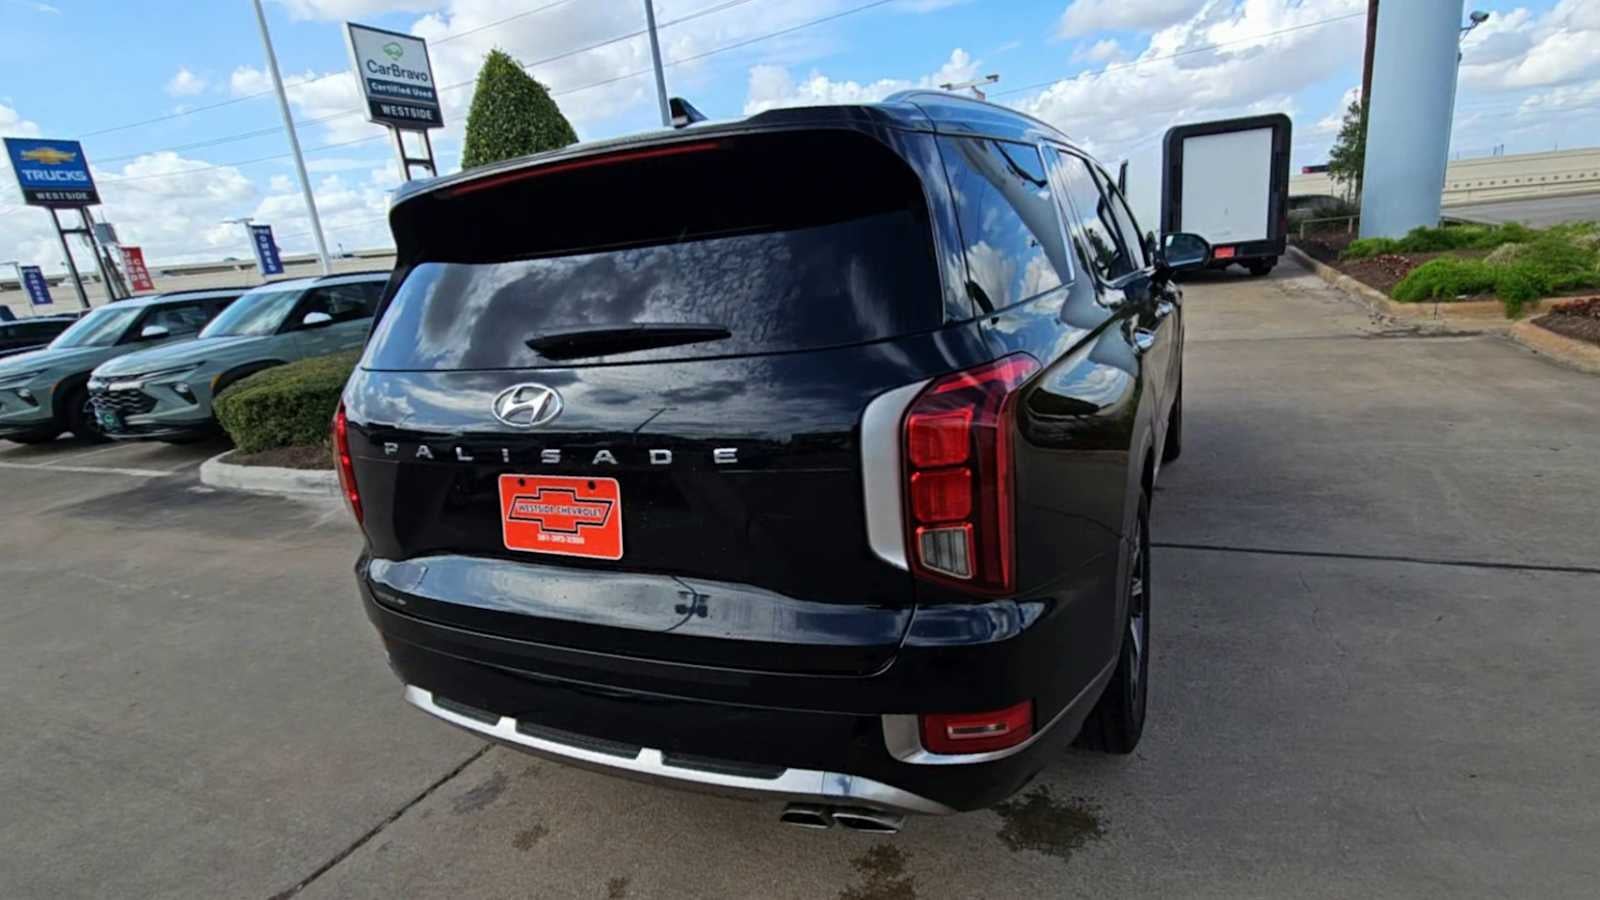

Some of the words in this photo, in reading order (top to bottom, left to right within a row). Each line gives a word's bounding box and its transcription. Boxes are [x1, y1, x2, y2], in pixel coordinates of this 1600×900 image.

[366, 59, 428, 82] CarBravo
[371, 82, 411, 96] Certified
[412, 87, 433, 98] Used
[380, 104, 433, 120] WESTSIDE
[21, 169, 87, 181] TRUCKS
[35, 191, 89, 200] WESTSIDE
[134, 258, 150, 288] CARS
[384, 442, 738, 465] PALISADE
[518, 504, 554, 513] WESTSIDE
[556, 505, 602, 516] CHEVROLET
